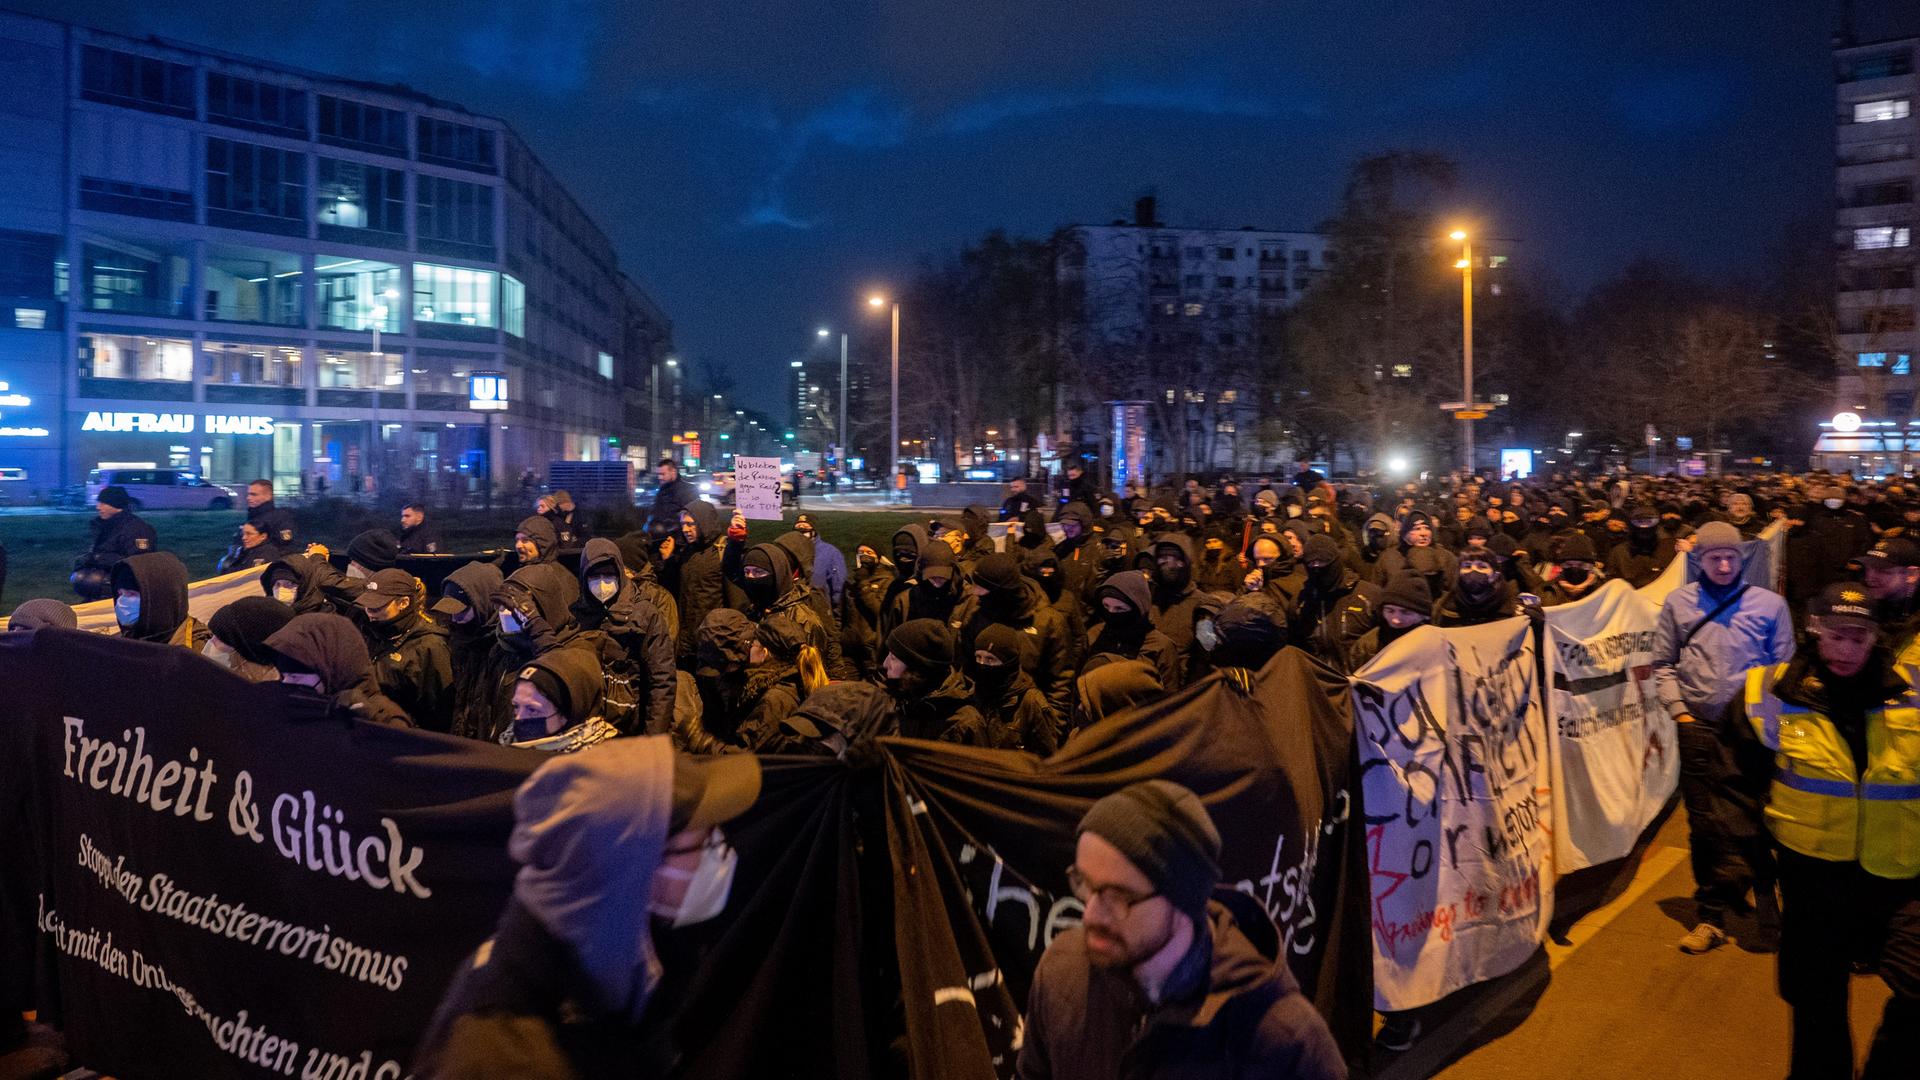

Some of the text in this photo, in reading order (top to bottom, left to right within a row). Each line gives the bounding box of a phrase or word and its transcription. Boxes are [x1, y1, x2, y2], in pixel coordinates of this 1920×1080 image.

[474, 378, 496, 400] U
[82, 411, 274, 434] AUFBAU HAUS
[63, 716, 432, 899] Freiheit & Glück
[112, 855, 143, 904] den
[140, 872, 408, 991] Staatsterrorismus
[67, 927, 100, 962] mit
[100, 932, 129, 979] den
